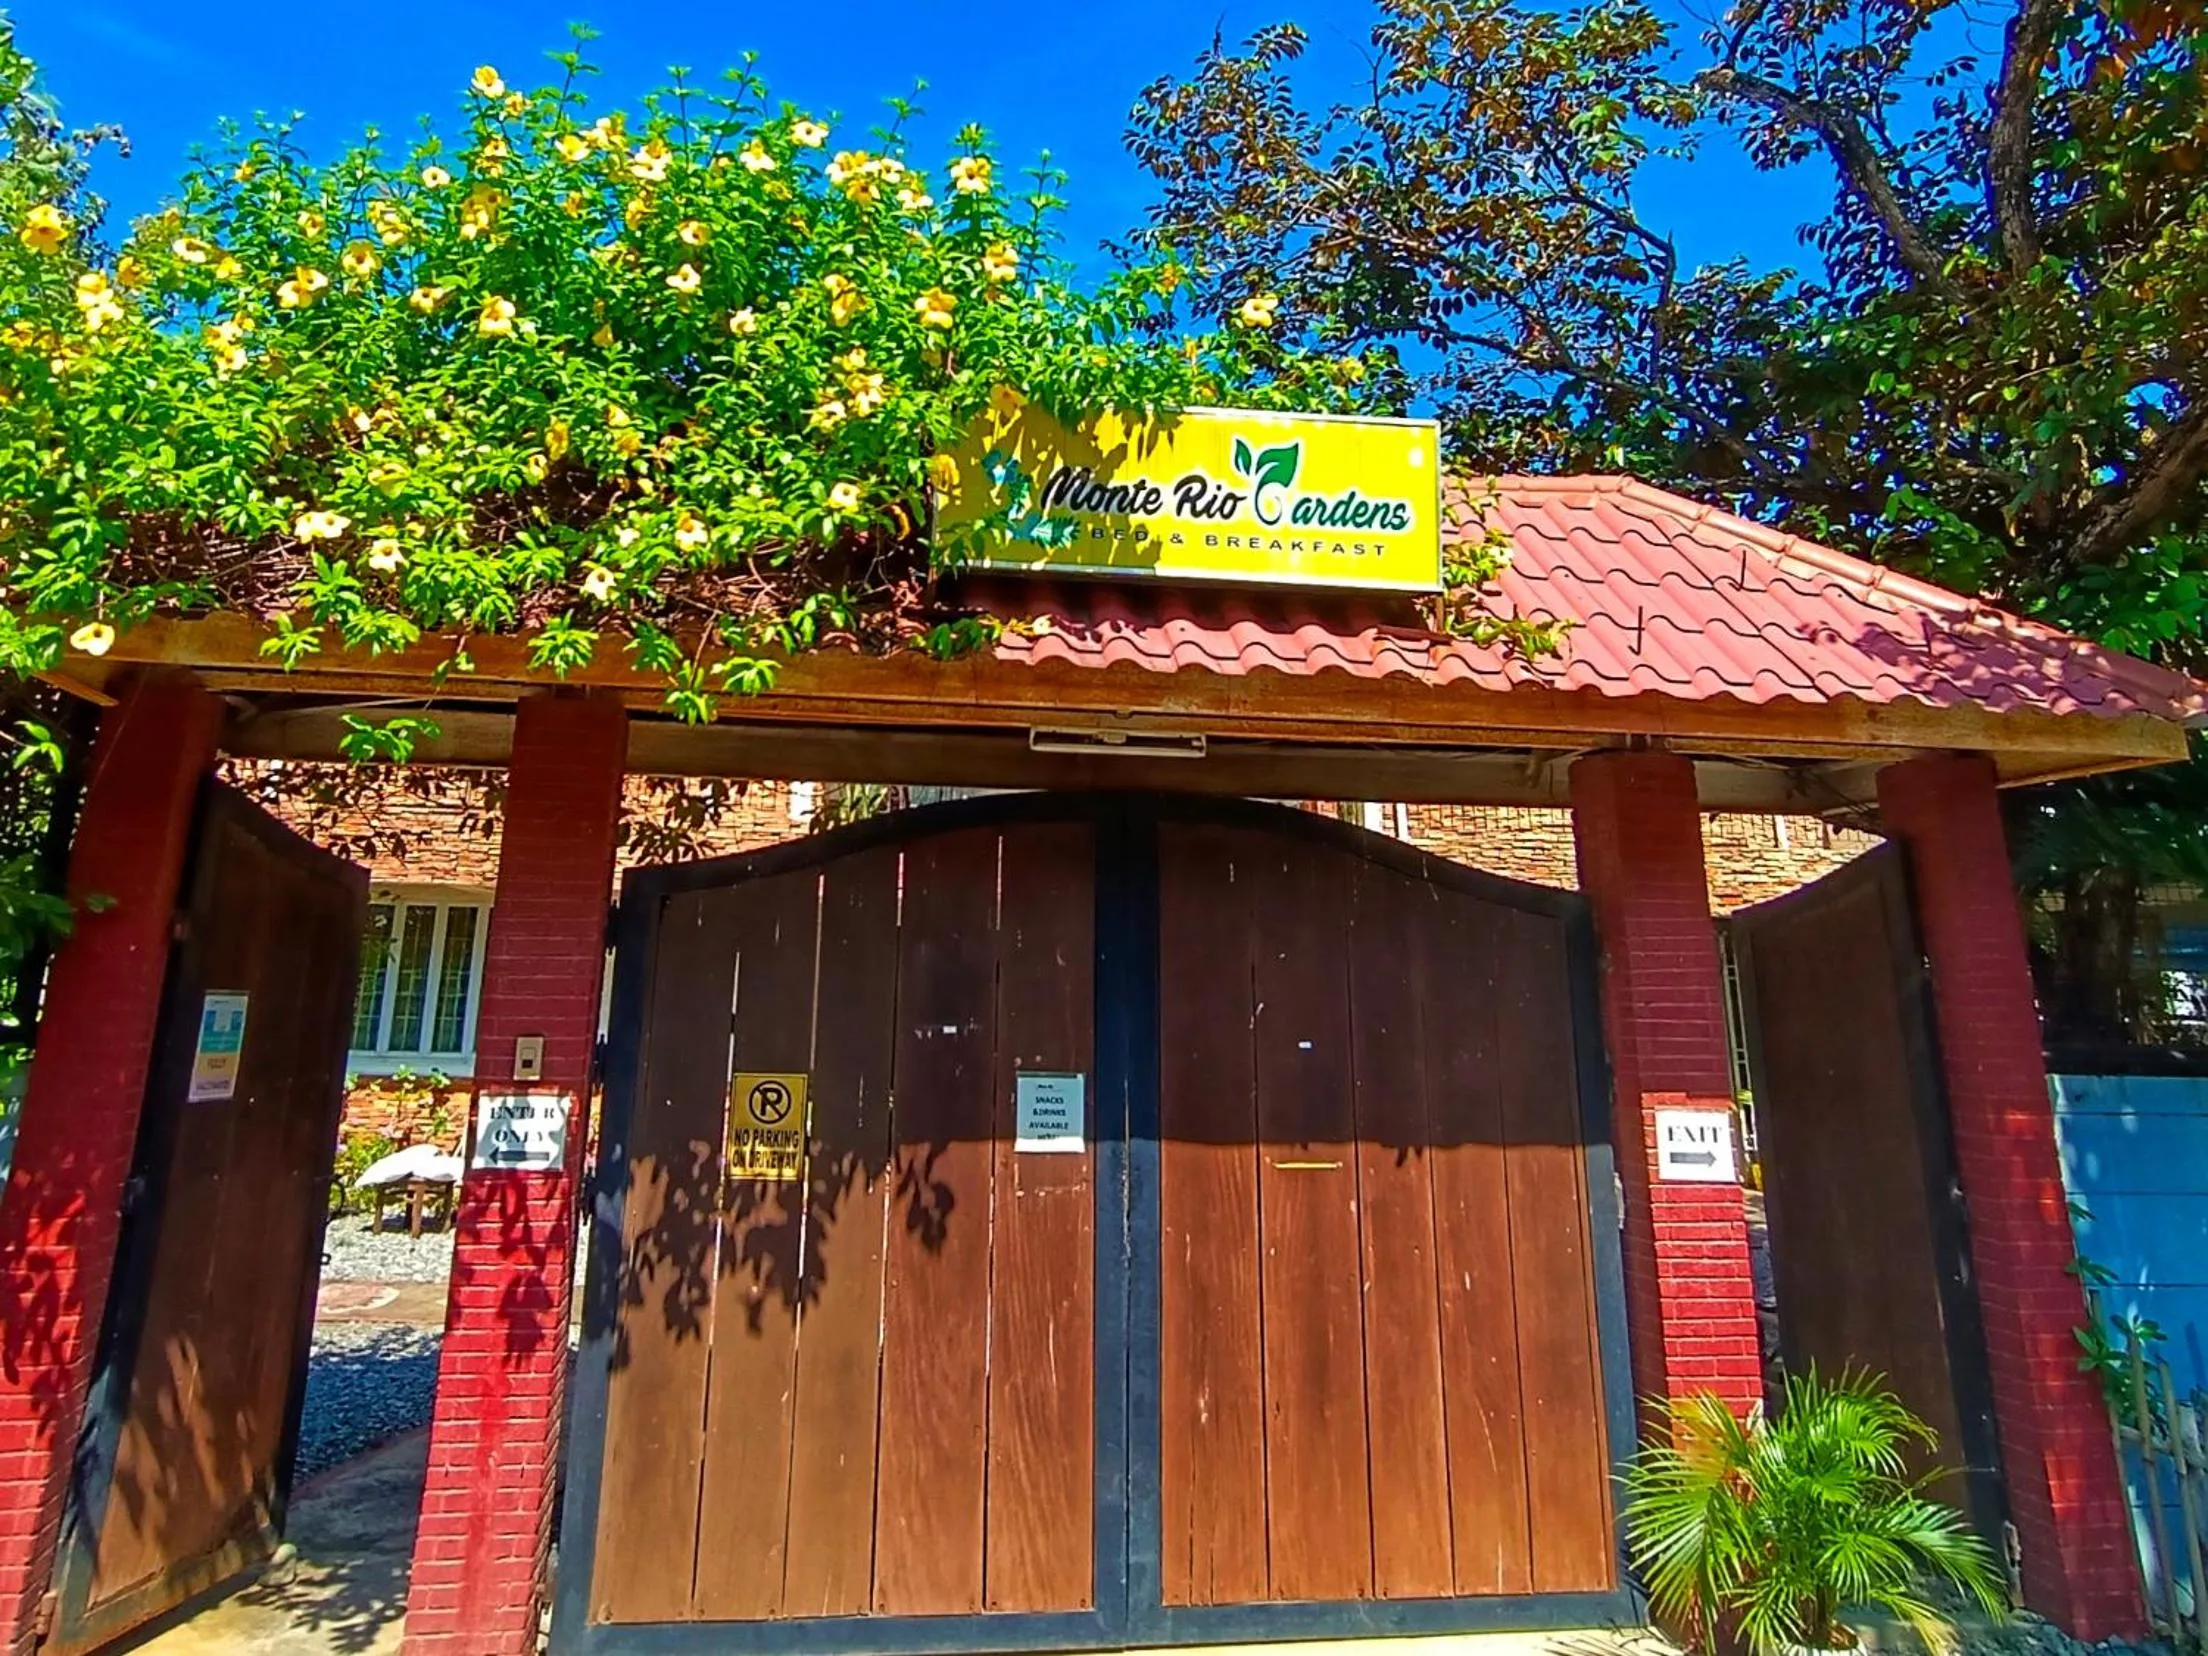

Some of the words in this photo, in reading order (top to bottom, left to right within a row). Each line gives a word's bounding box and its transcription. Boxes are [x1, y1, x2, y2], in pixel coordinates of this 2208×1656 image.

[1041, 465, 1164, 516] Monte
[1173, 474, 1248, 520] Rio
[1254, 442, 1410, 531] Gardens
[1091, 528, 1149, 542] BED
[1169, 532, 1185, 545] &
[1205, 534, 1385, 556] BREAKFAST
[734, 1128, 750, 1147] NO
[754, 1129, 799, 1148] PARKING
[1668, 1126, 1722, 1143] EXIT
[732, 1148, 746, 1168] ON
[749, 1149, 798, 1169] DRIVEWAY
